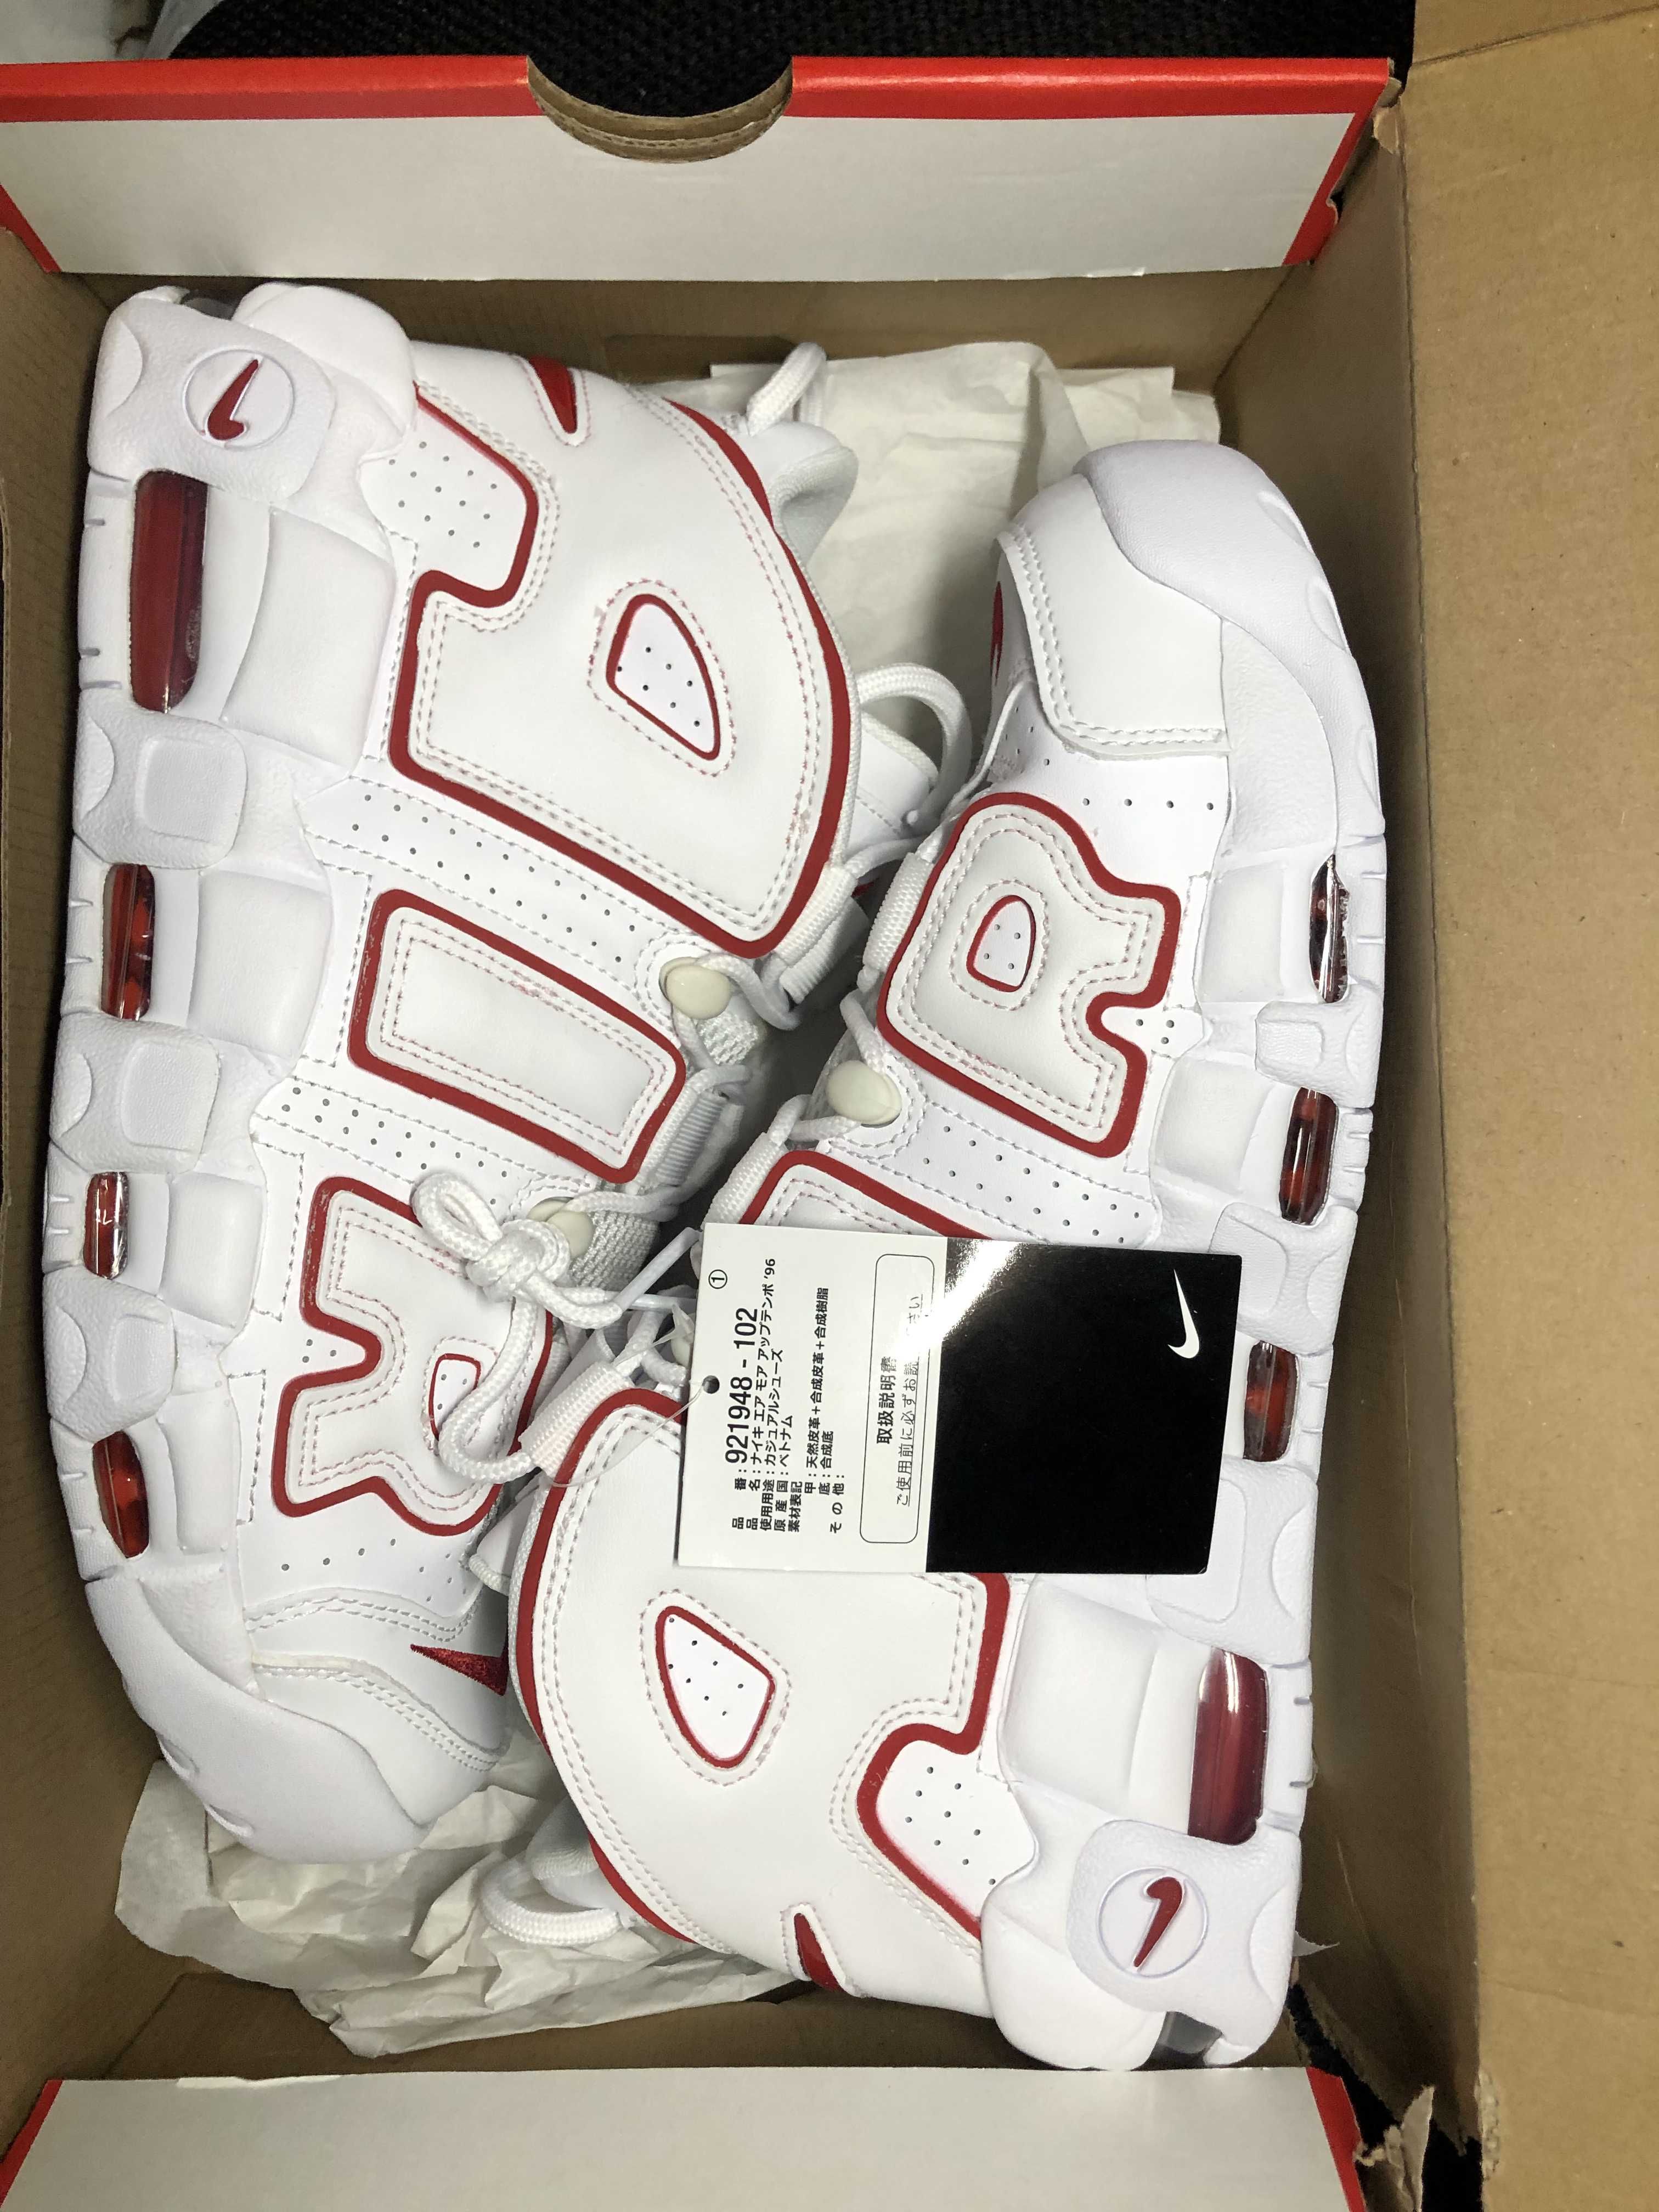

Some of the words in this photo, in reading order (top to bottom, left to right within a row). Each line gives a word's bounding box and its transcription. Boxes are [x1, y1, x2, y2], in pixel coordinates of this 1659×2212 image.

[733, 1307, 757, 1348] 102
[751, 1425, 764, 1464] ナイキ
[758, 1283, 774, 1359] アップテンポ
[725, 1376, 752, 1463] 921948
[779, 1415, 793, 1466] ベトナム
[820, 1430, 834, 1469] 合成底
[788, 1481, 803, 1532] 素材表記
